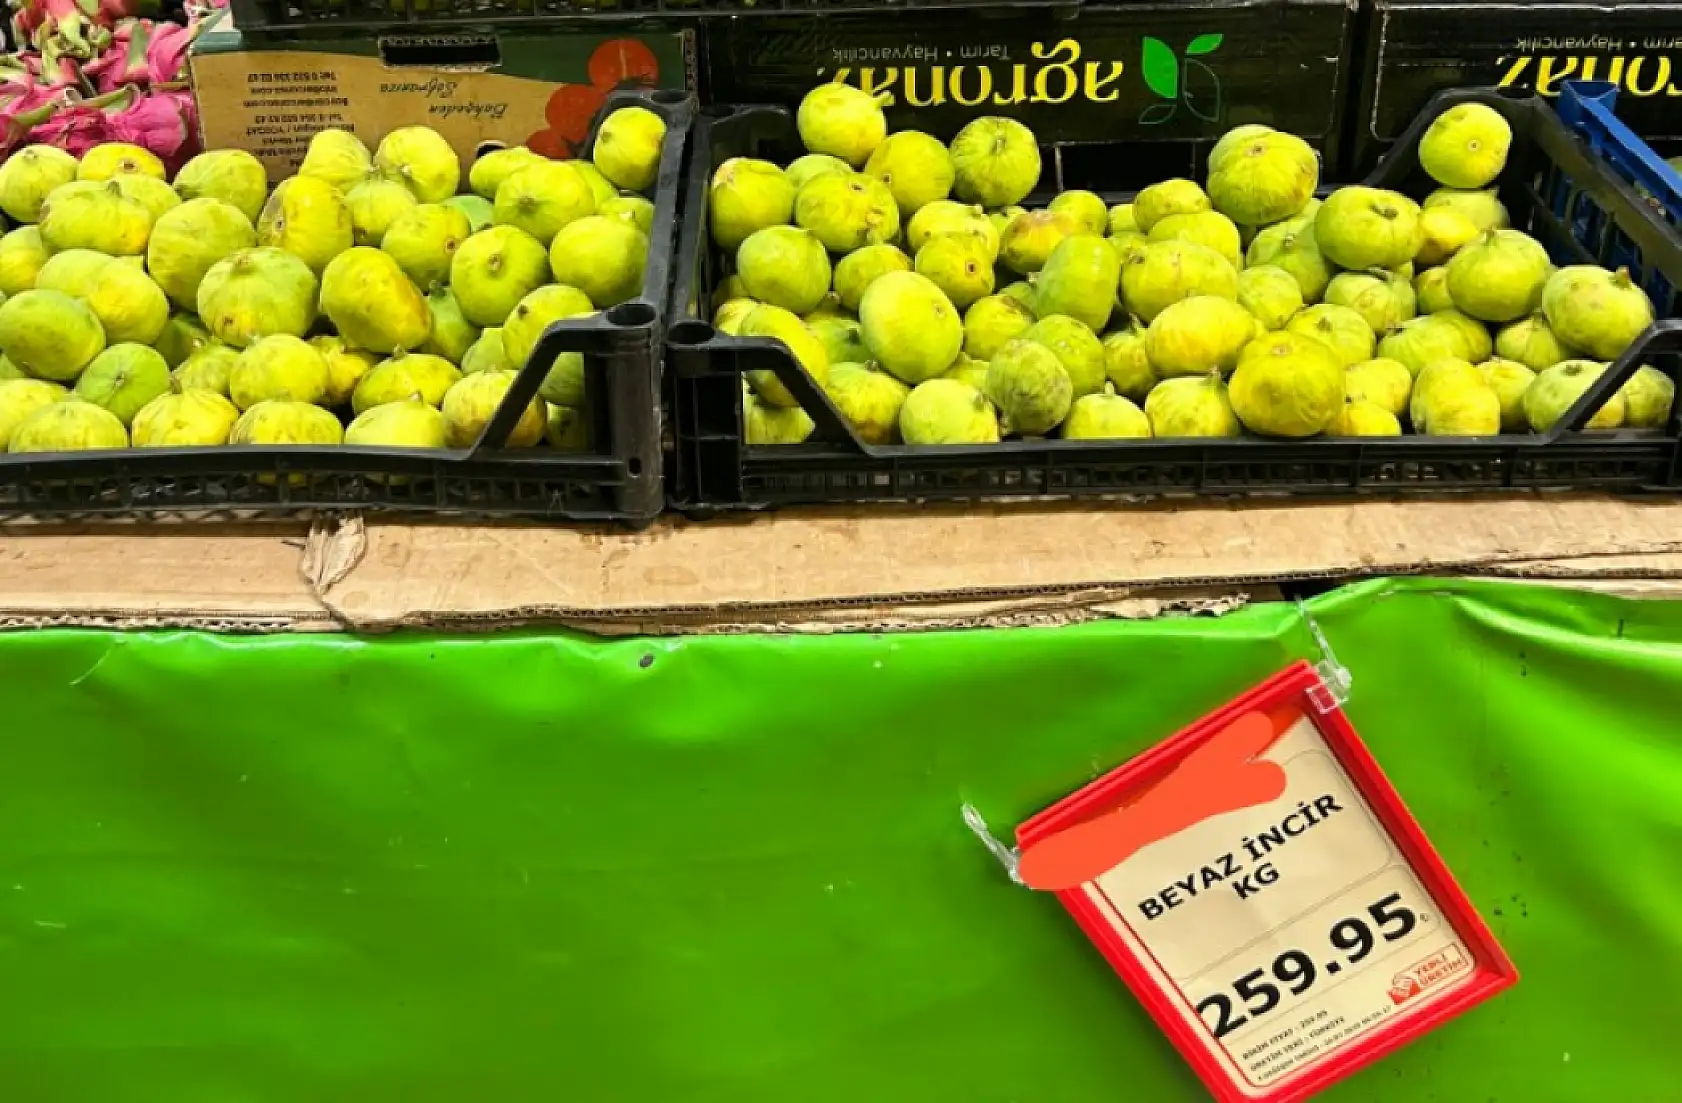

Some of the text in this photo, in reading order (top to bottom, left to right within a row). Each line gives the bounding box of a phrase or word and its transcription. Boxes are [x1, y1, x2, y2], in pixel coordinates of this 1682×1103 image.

[832, 43, 1011, 64] Tarım Hayvancılık
[1138, 794, 1343, 920] BEYAZ İNCİR
[1232, 863, 1280, 899] KG
[1196, 891, 1416, 1038] 259.95
